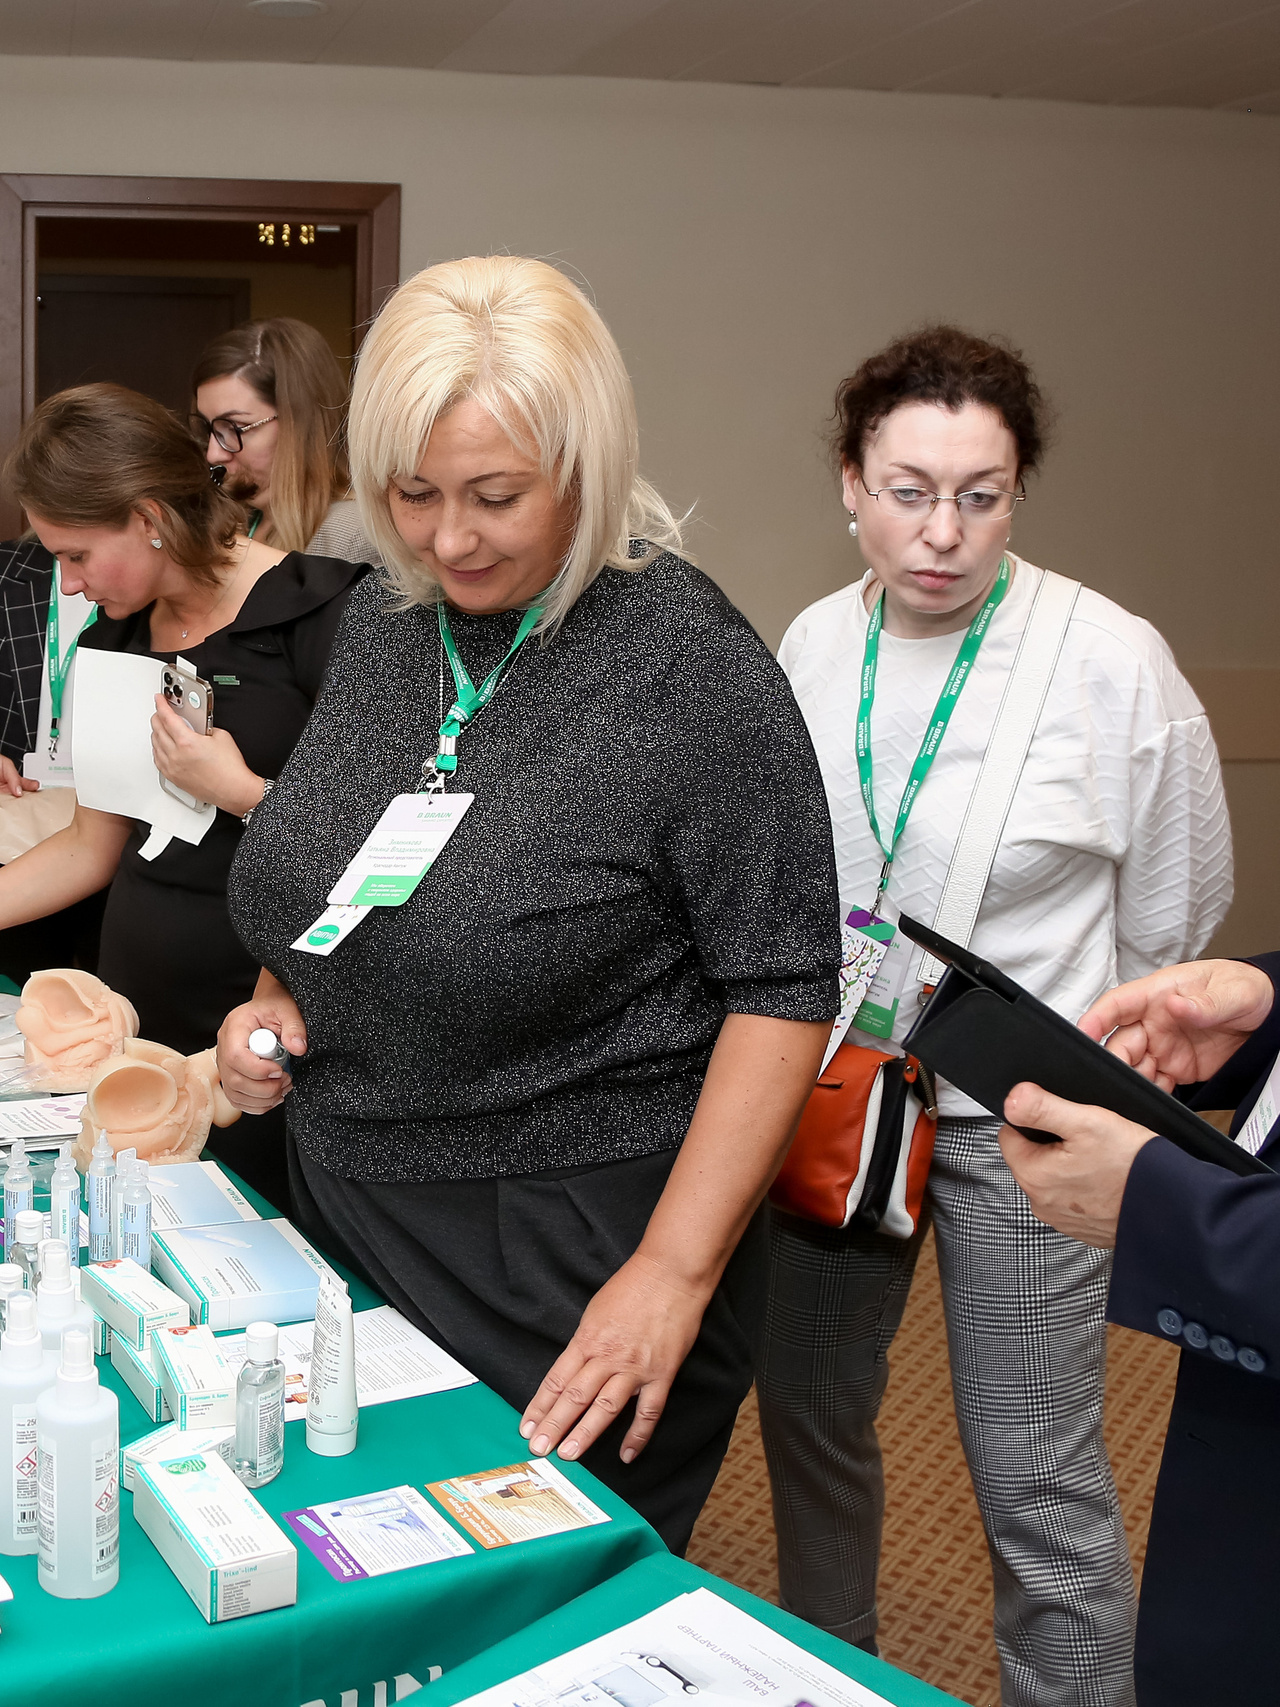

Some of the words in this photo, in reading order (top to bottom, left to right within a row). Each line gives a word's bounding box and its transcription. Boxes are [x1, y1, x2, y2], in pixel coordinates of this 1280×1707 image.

[975, 609, 991, 636] BRAUN
[863, 665, 871, 692] BRAUN
[949, 667, 966, 696] BRAUN
[927, 727, 942, 756] BRAUN
[902, 787, 916, 815] BRAUN
[677, 1624, 721, 1653] ПАРТНЕР
[719, 1651, 780, 1691] НАДЕЖНЫЙ
[742, 1679, 770, 1697] ВАШ
